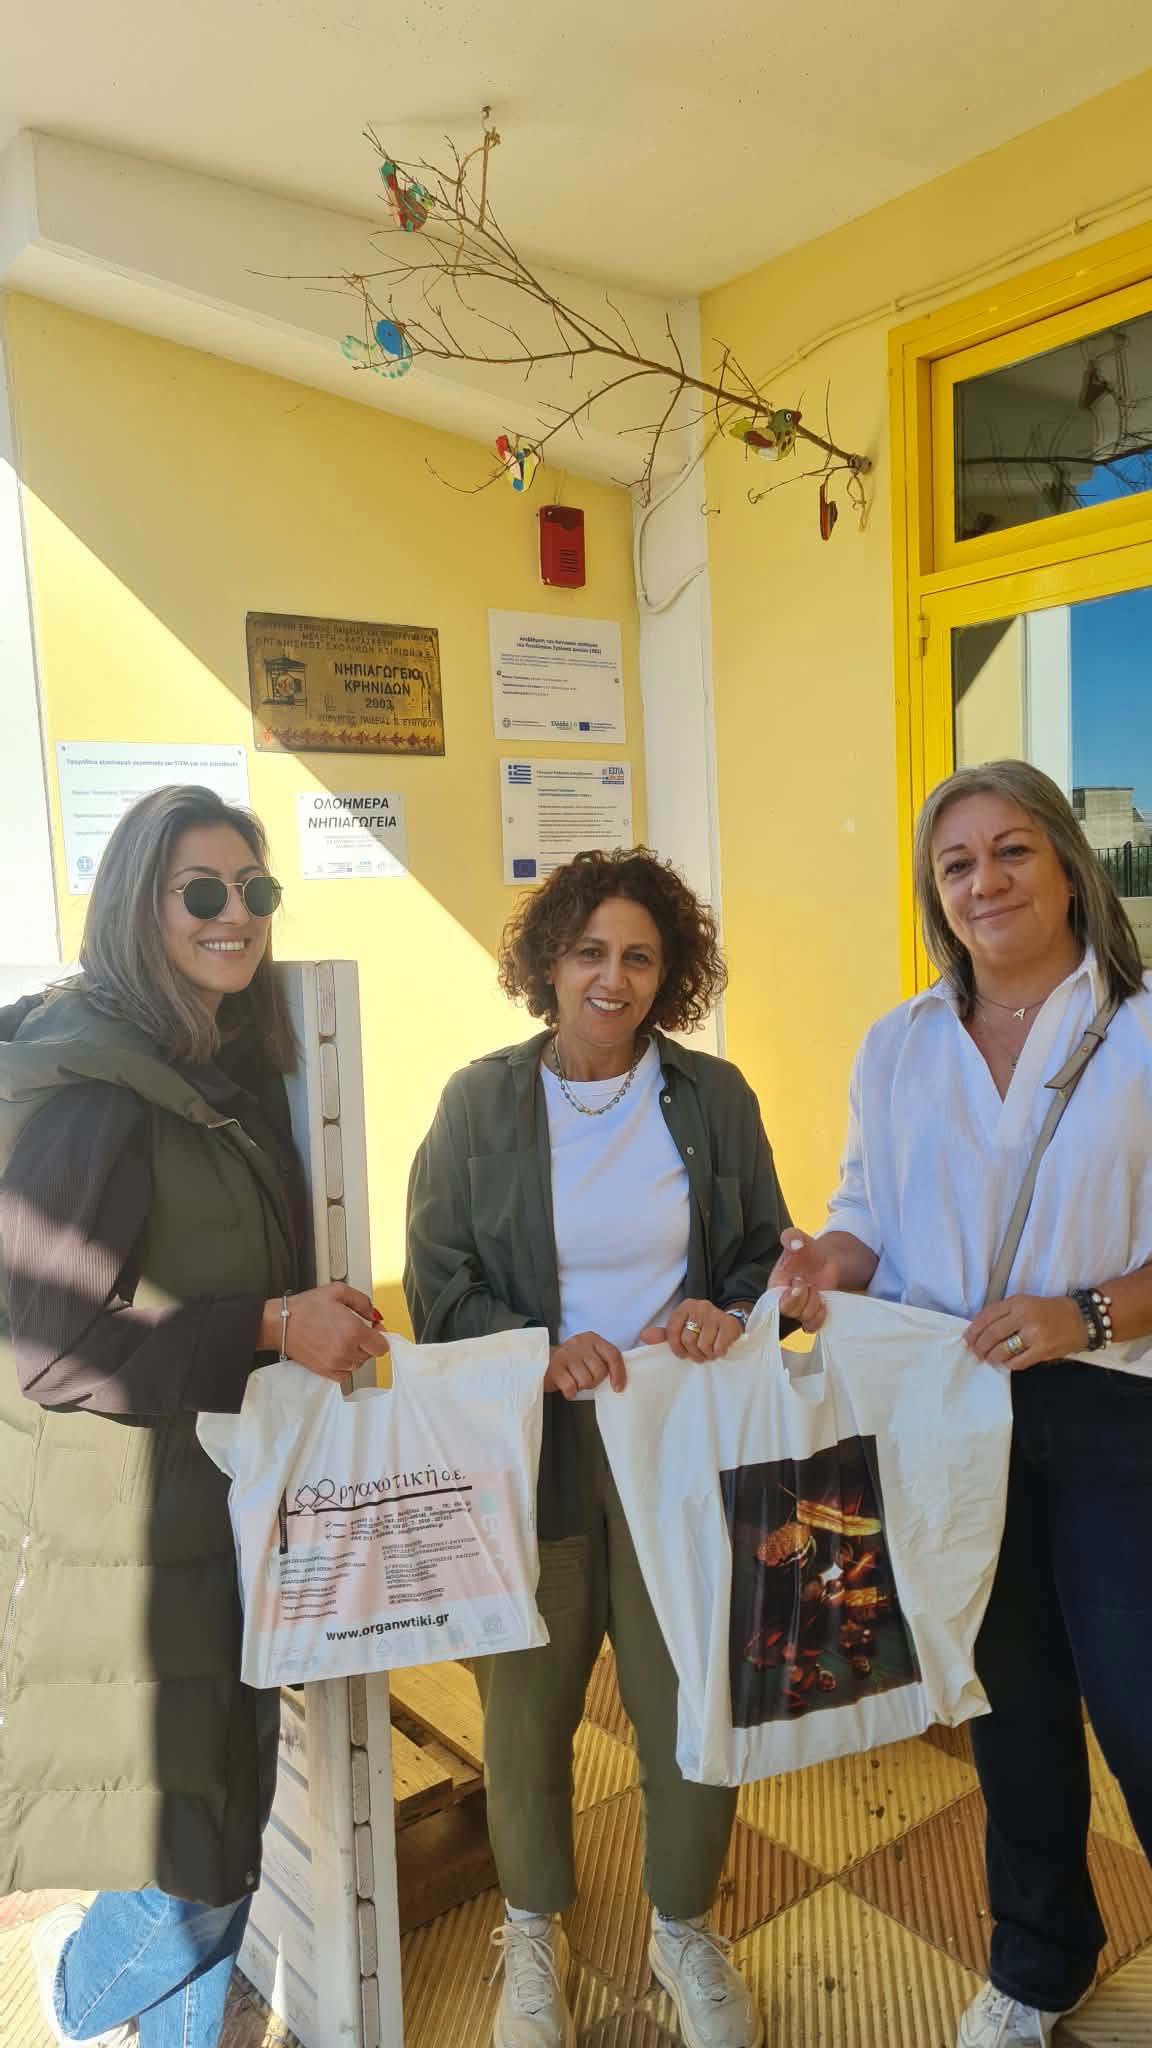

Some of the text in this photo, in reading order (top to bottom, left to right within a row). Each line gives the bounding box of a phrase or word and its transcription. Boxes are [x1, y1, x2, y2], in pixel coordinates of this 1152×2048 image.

[334, 662, 422, 681] ΝΗΠΙΑΓΩΓΕΙΟ
[344, 679, 411, 697] ΚΡΗΝΙΔΩΝ
[366, 697, 393, 710] 2003
[608, 766, 624, 775] ΕΣΠΑ
[313, 797, 389, 810] ΟΛΟΗΜΕΡΑ
[308, 815, 398, 829] ΝΗΠΙΑΓΩΓΕΙΑ
[326, 1611, 450, 1642] www.organwtiki.gr
